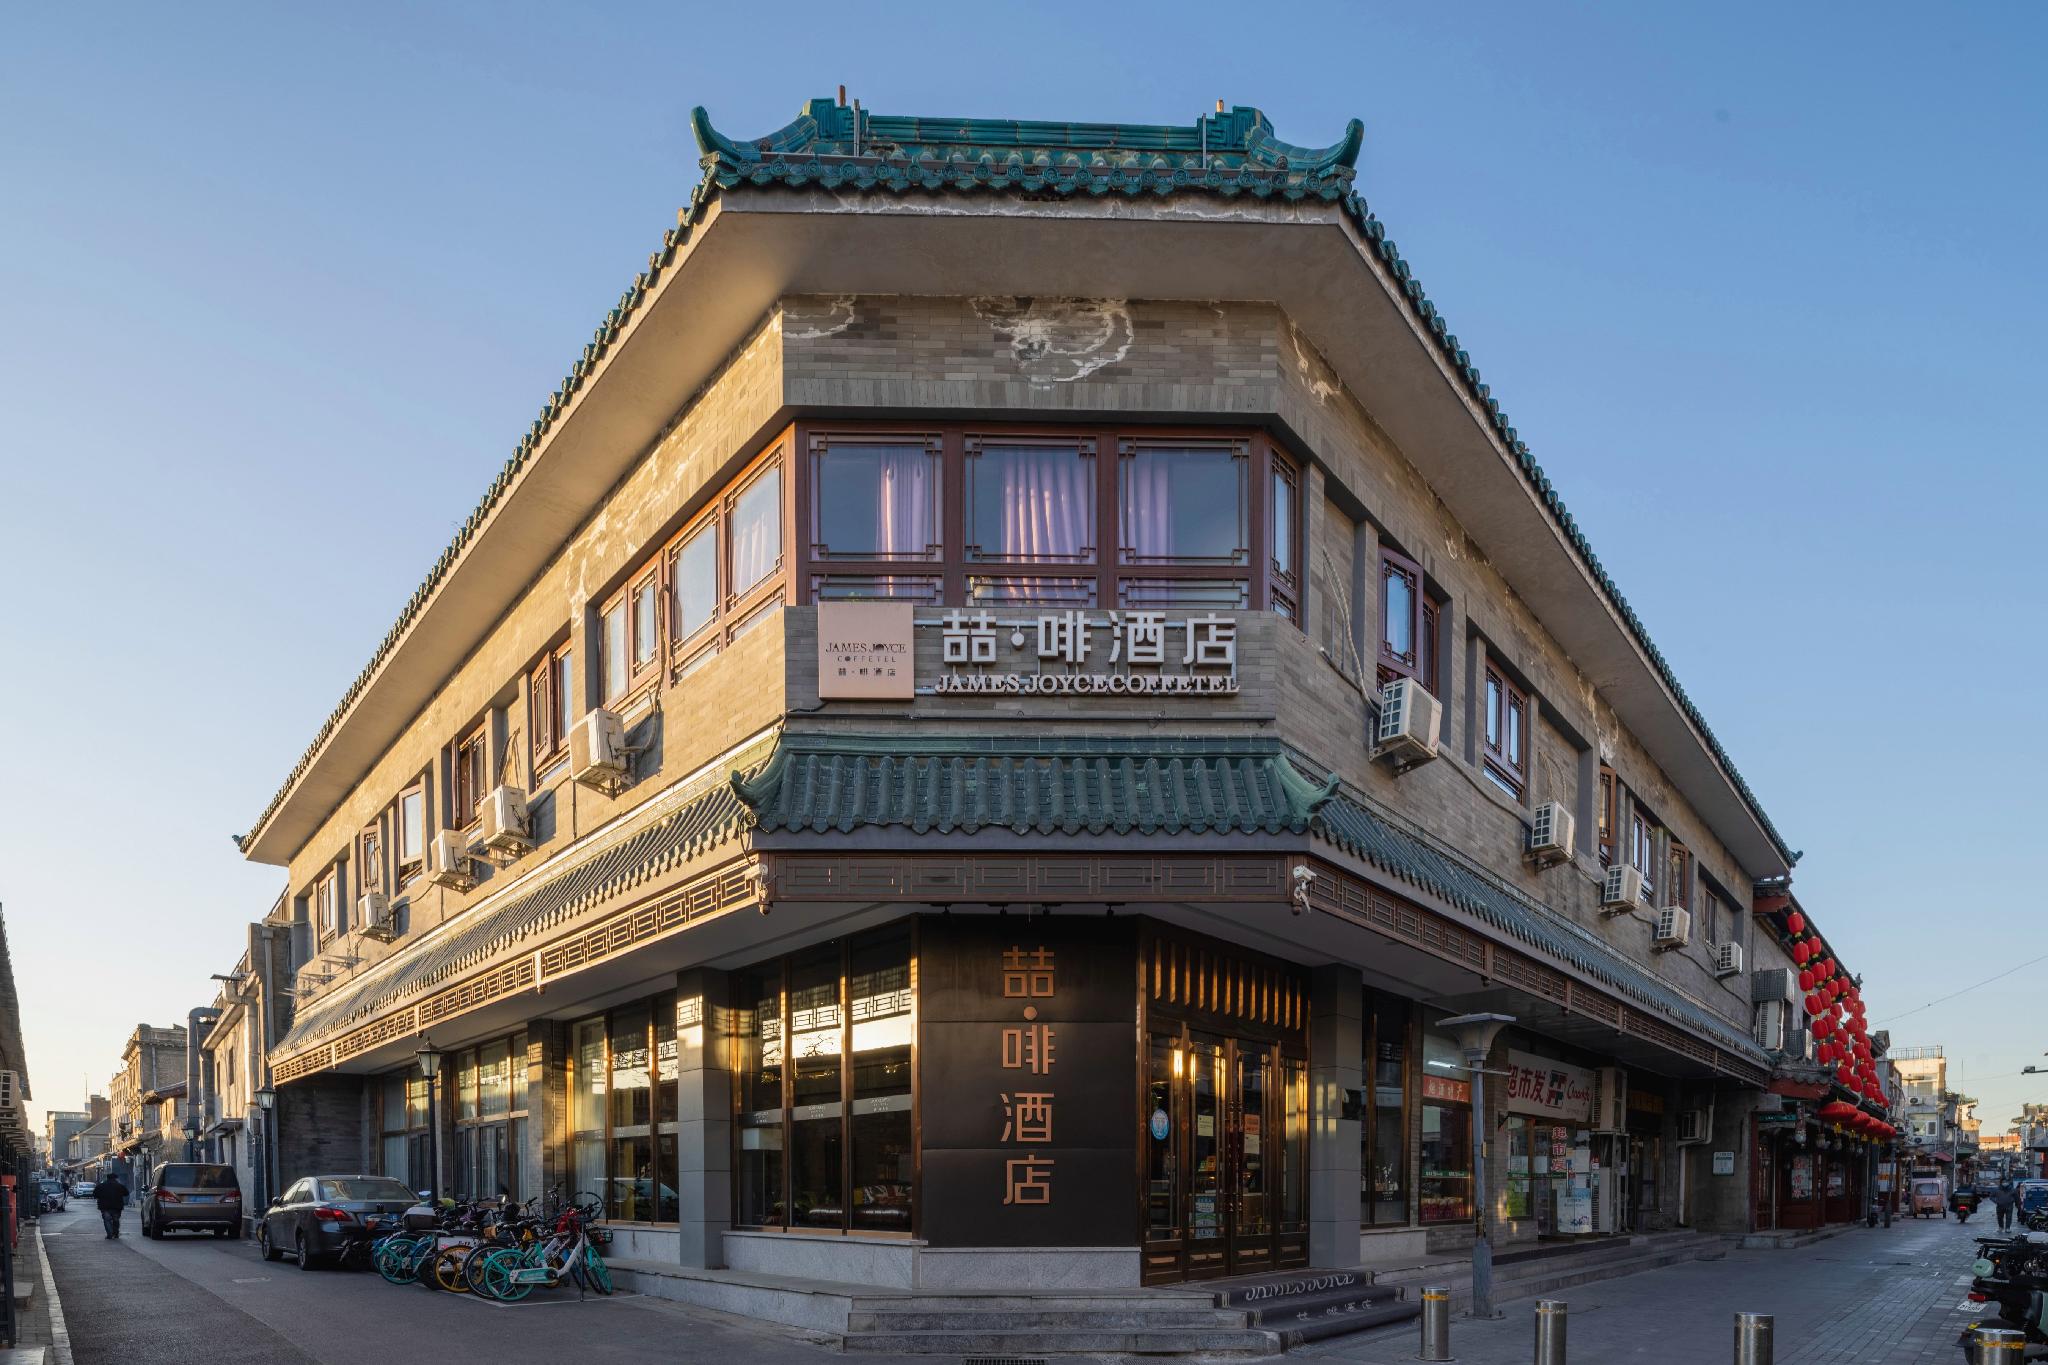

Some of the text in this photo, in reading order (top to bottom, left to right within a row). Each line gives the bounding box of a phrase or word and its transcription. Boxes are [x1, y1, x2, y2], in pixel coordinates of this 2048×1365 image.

[825, 642, 907, 653] JAMES JOYCE
[935, 674, 1020, 694] JAMES
